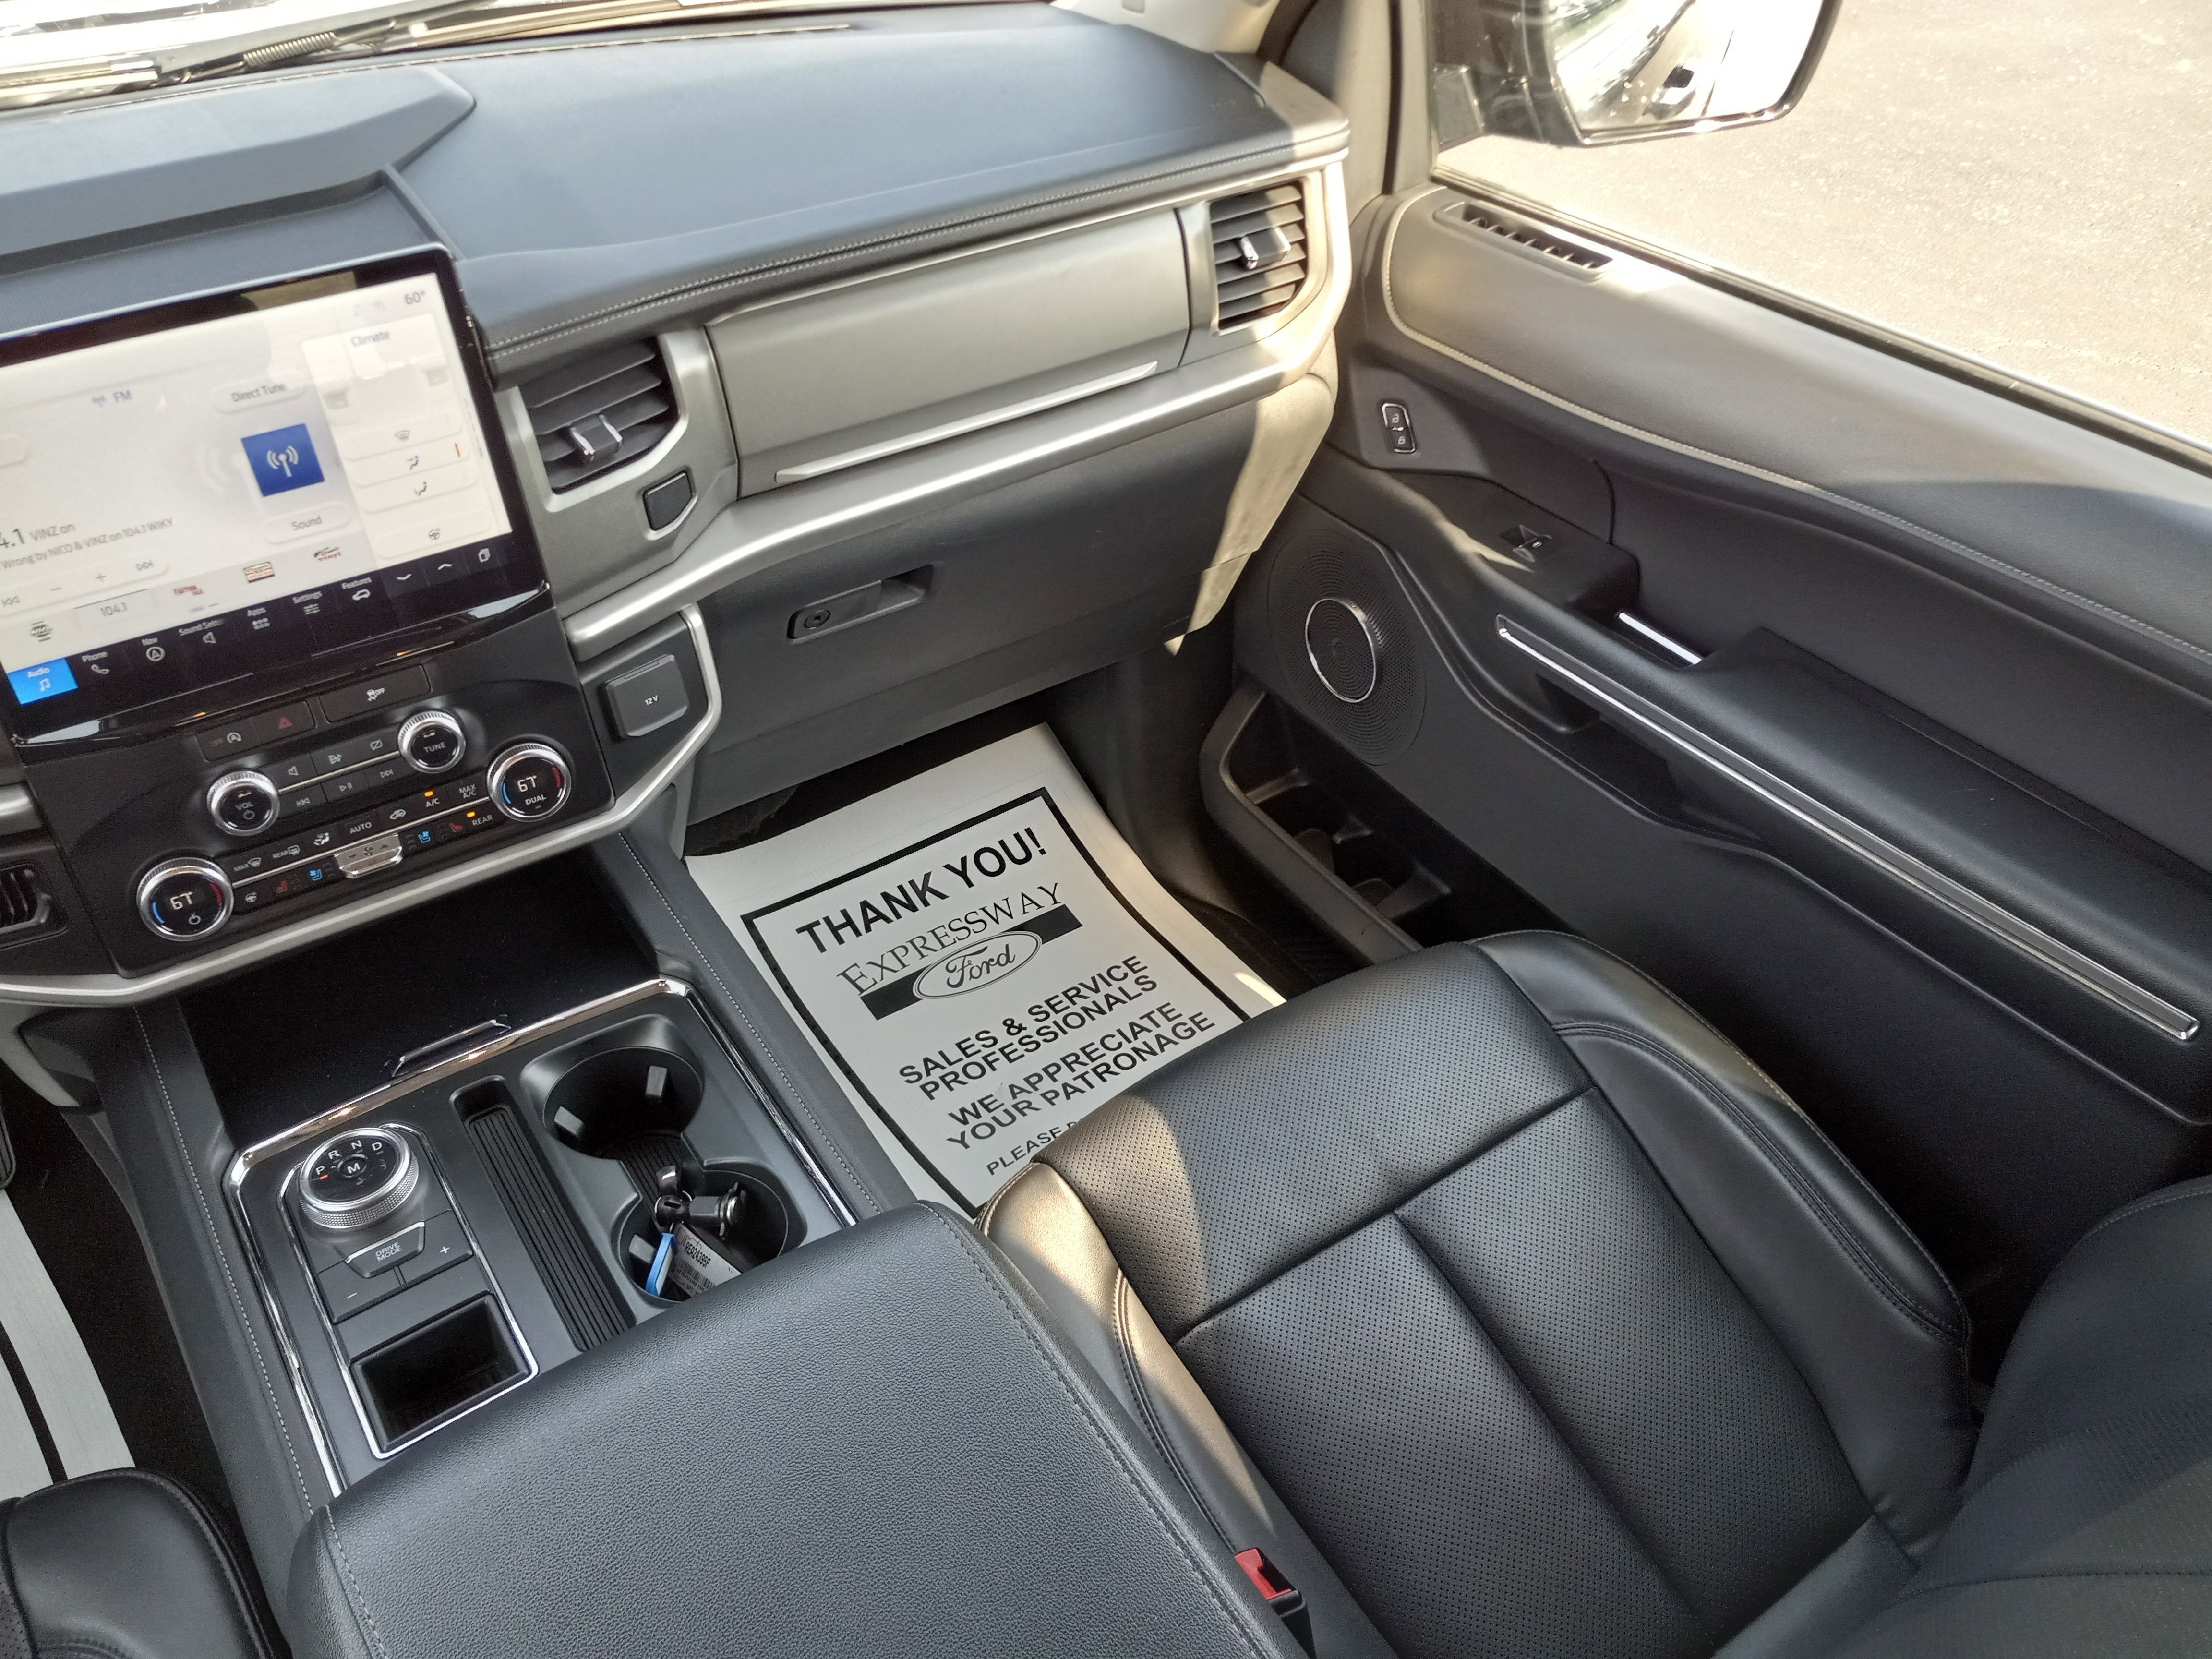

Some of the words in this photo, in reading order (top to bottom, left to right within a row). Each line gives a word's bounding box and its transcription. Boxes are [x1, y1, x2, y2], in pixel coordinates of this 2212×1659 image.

[351, 331, 391, 347] Climate
[113, 390, 131, 403] FM
[231, 388, 260, 402] Direct
[261, 384, 287, 394] Tune
[60, 524, 76, 534] on
[292, 516, 322, 530] Sound
[342, 577, 372, 589] Features
[292, 591, 323, 604] Settings
[247, 607, 266, 617] Apps
[178, 624, 203, 636] Sound
[82, 651, 108, 663] Phone
[27, 667, 50, 678] Audio
[375, 687, 385, 696] OFF
[423, 741, 446, 754] TUNE
[458, 784, 476, 794] MAX
[463, 790, 477, 799] A/C
[425, 797, 440, 808] A/C
[525, 794, 547, 805] DUAL
[236, 801, 254, 811] VOL
[472, 815, 493, 826] REAR
[349, 822, 372, 834] AUTO
[272, 850, 289, 858] REAR
[795, 871, 950, 954] THANK
[942, 827, 1047, 889] YOU!
[836, 882, 1063, 996] EXPRESSWAY
[945, 944, 1016, 988] Ford
[899, 1029, 998, 1084] SALES
[1002, 1017, 1027, 1036] &
[1027, 955, 1149, 1023] SERVICE
[919, 974, 1157, 1101] PROFESSIONALS
[948, 1094, 1005, 1126] WE
[1008, 1002, 1183, 1104] APPRECIATE
[946, 1099, 1042, 1151] YOUR
[1039, 1011, 1215, 1106] PATRONAGE
[351, 1140, 362, 1150] N
[372, 1142, 382, 1151] D
[328, 1150, 342, 1160] R
[315, 1166, 325, 1175] P
[347, 1162, 360, 1174] M
[375, 1241, 399, 1257] DRIVE
[377, 1245, 403, 1262] MODE
